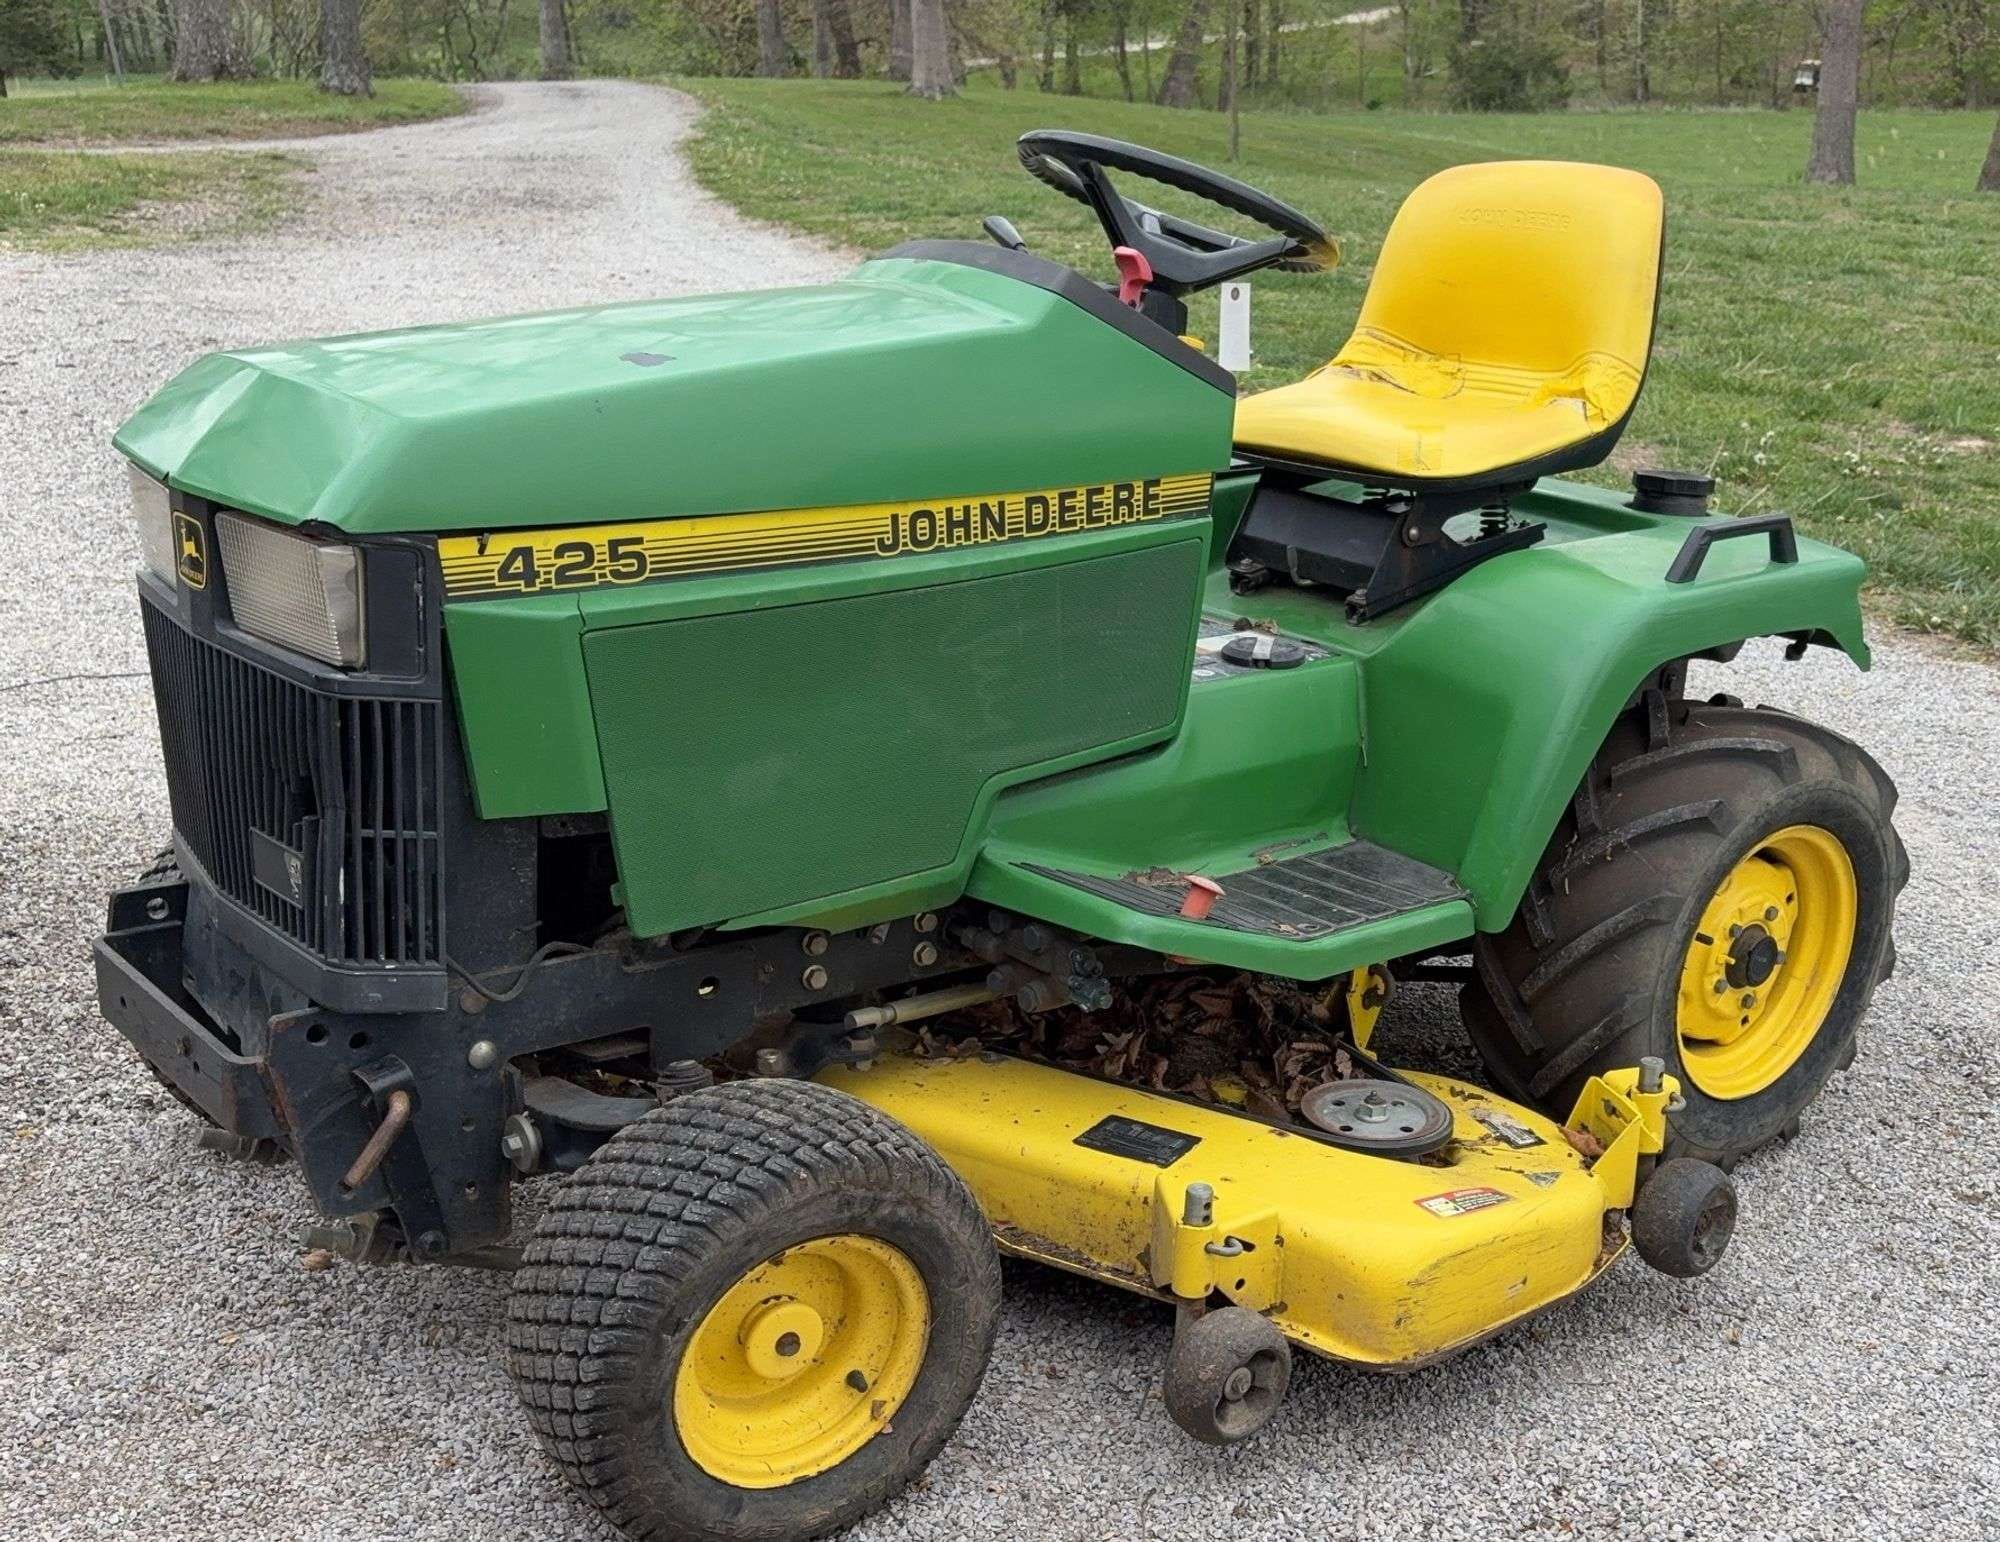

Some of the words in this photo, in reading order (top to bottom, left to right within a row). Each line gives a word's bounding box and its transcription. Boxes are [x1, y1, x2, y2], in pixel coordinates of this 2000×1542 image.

[876, 499, 1006, 556] JOHN
[1024, 479, 1162, 537] DEERE
[496, 536, 649, 592] 425
